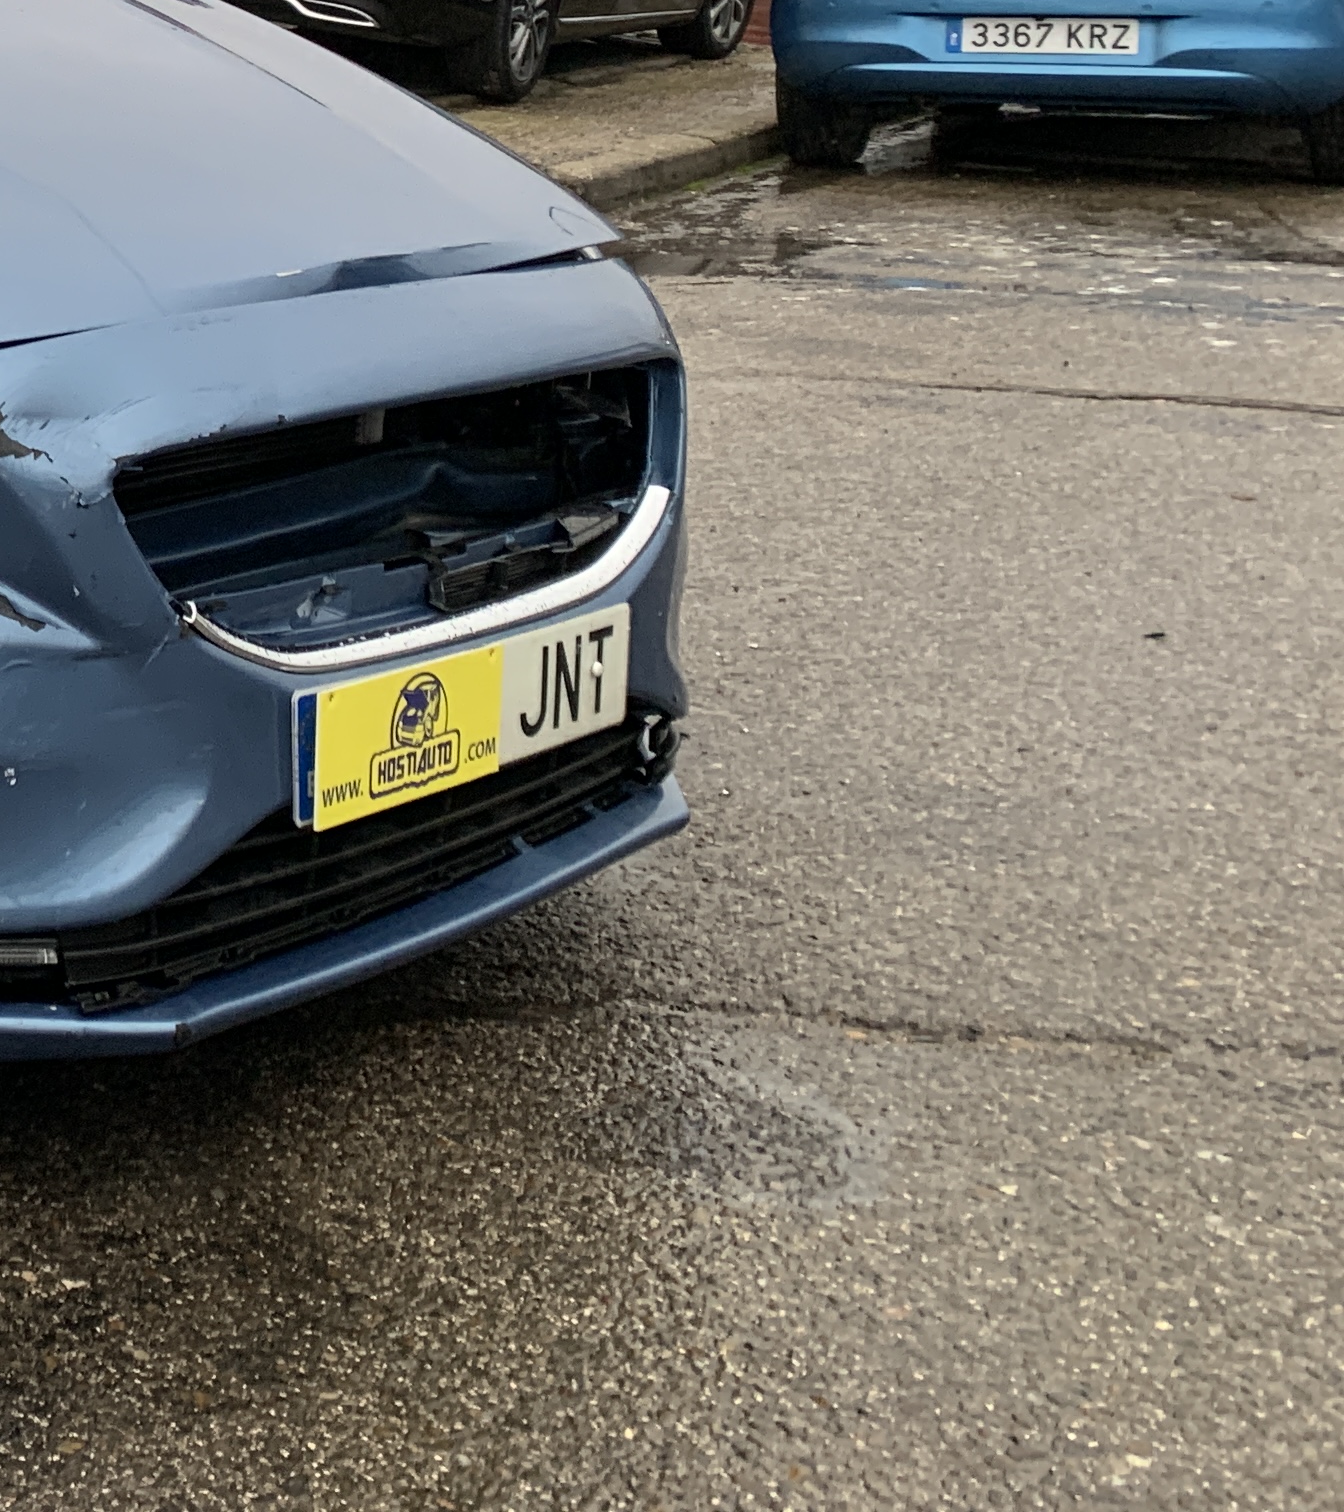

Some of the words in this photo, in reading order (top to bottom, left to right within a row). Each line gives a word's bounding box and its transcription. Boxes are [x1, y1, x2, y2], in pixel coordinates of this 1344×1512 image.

[971, 22, 1053, 48] 3367
[1067, 24, 1130, 50] KRZ
[520, 625, 614, 738] JNT
[377, 740, 453, 786] HOSTIAUTO
